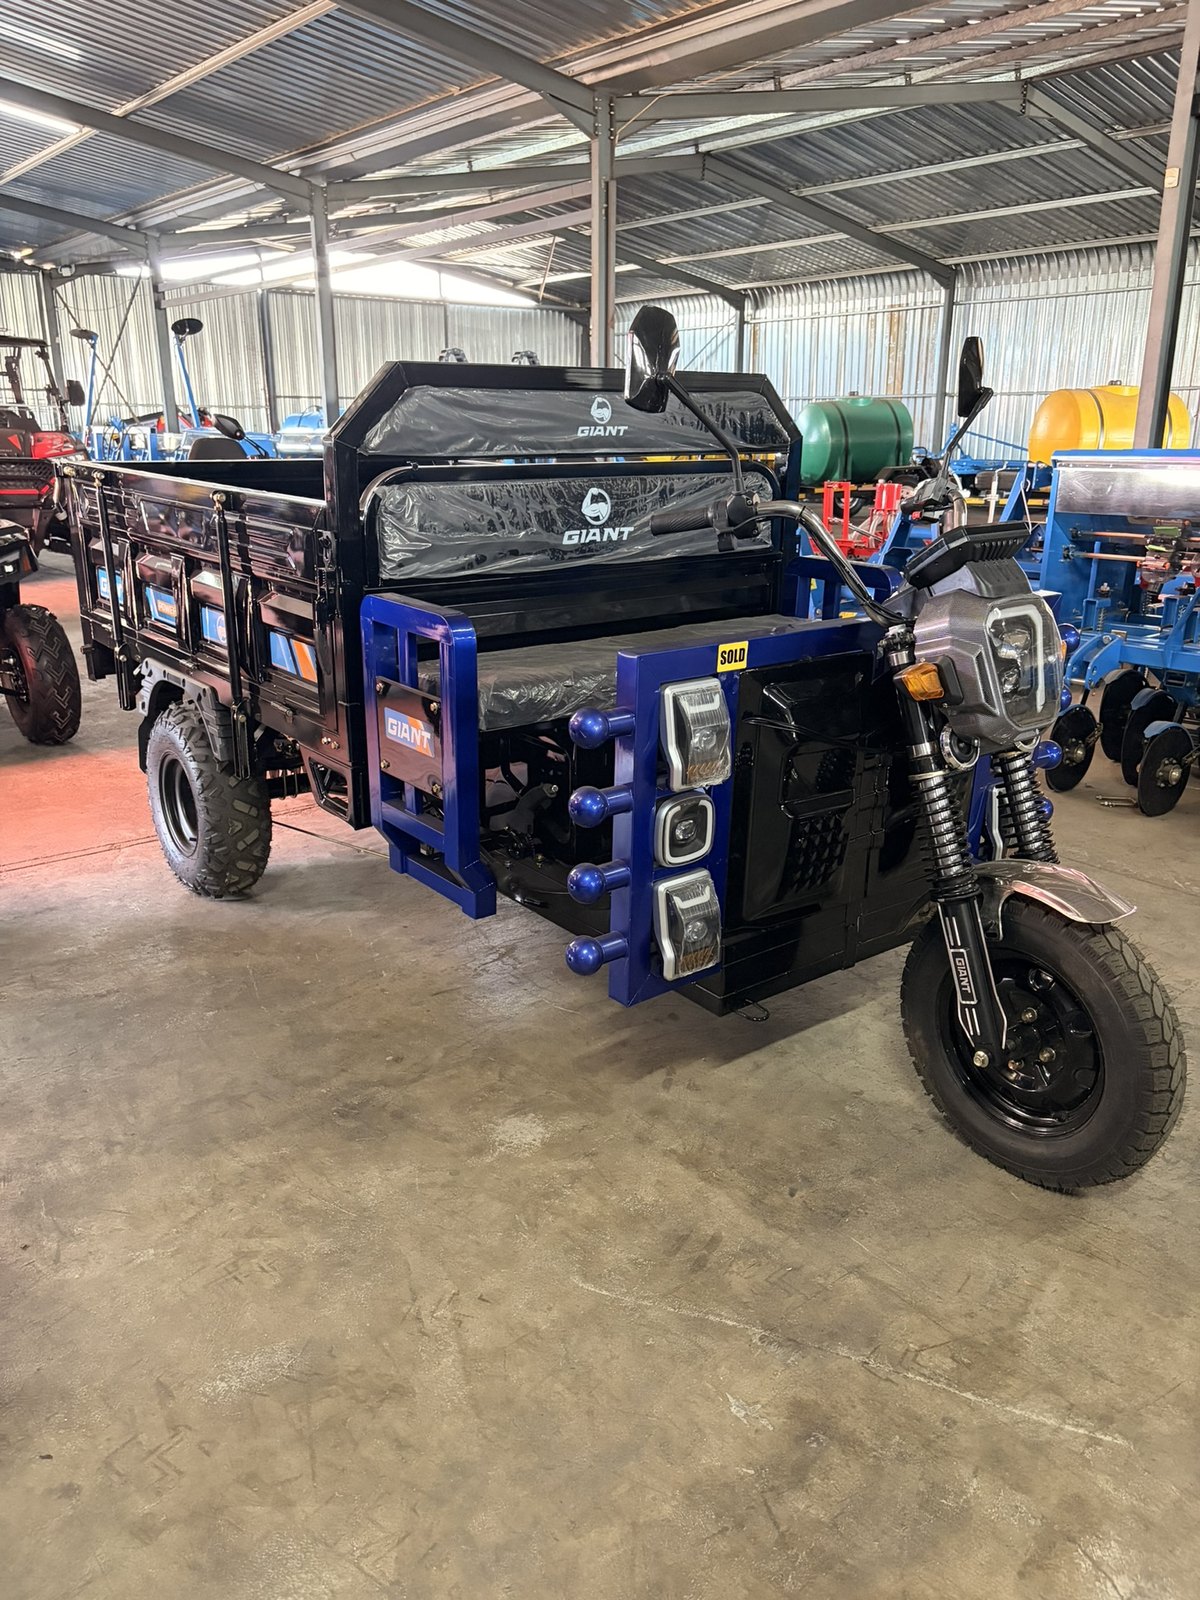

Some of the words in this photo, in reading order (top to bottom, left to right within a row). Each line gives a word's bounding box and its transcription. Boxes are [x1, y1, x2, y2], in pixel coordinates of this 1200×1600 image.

[577, 425, 628, 437] GIANT
[562, 526, 634, 545] GIANT
[720, 647, 746, 665] SOLD
[387, 717, 431, 749] GIANT
[955, 957, 971, 994] GIANT
